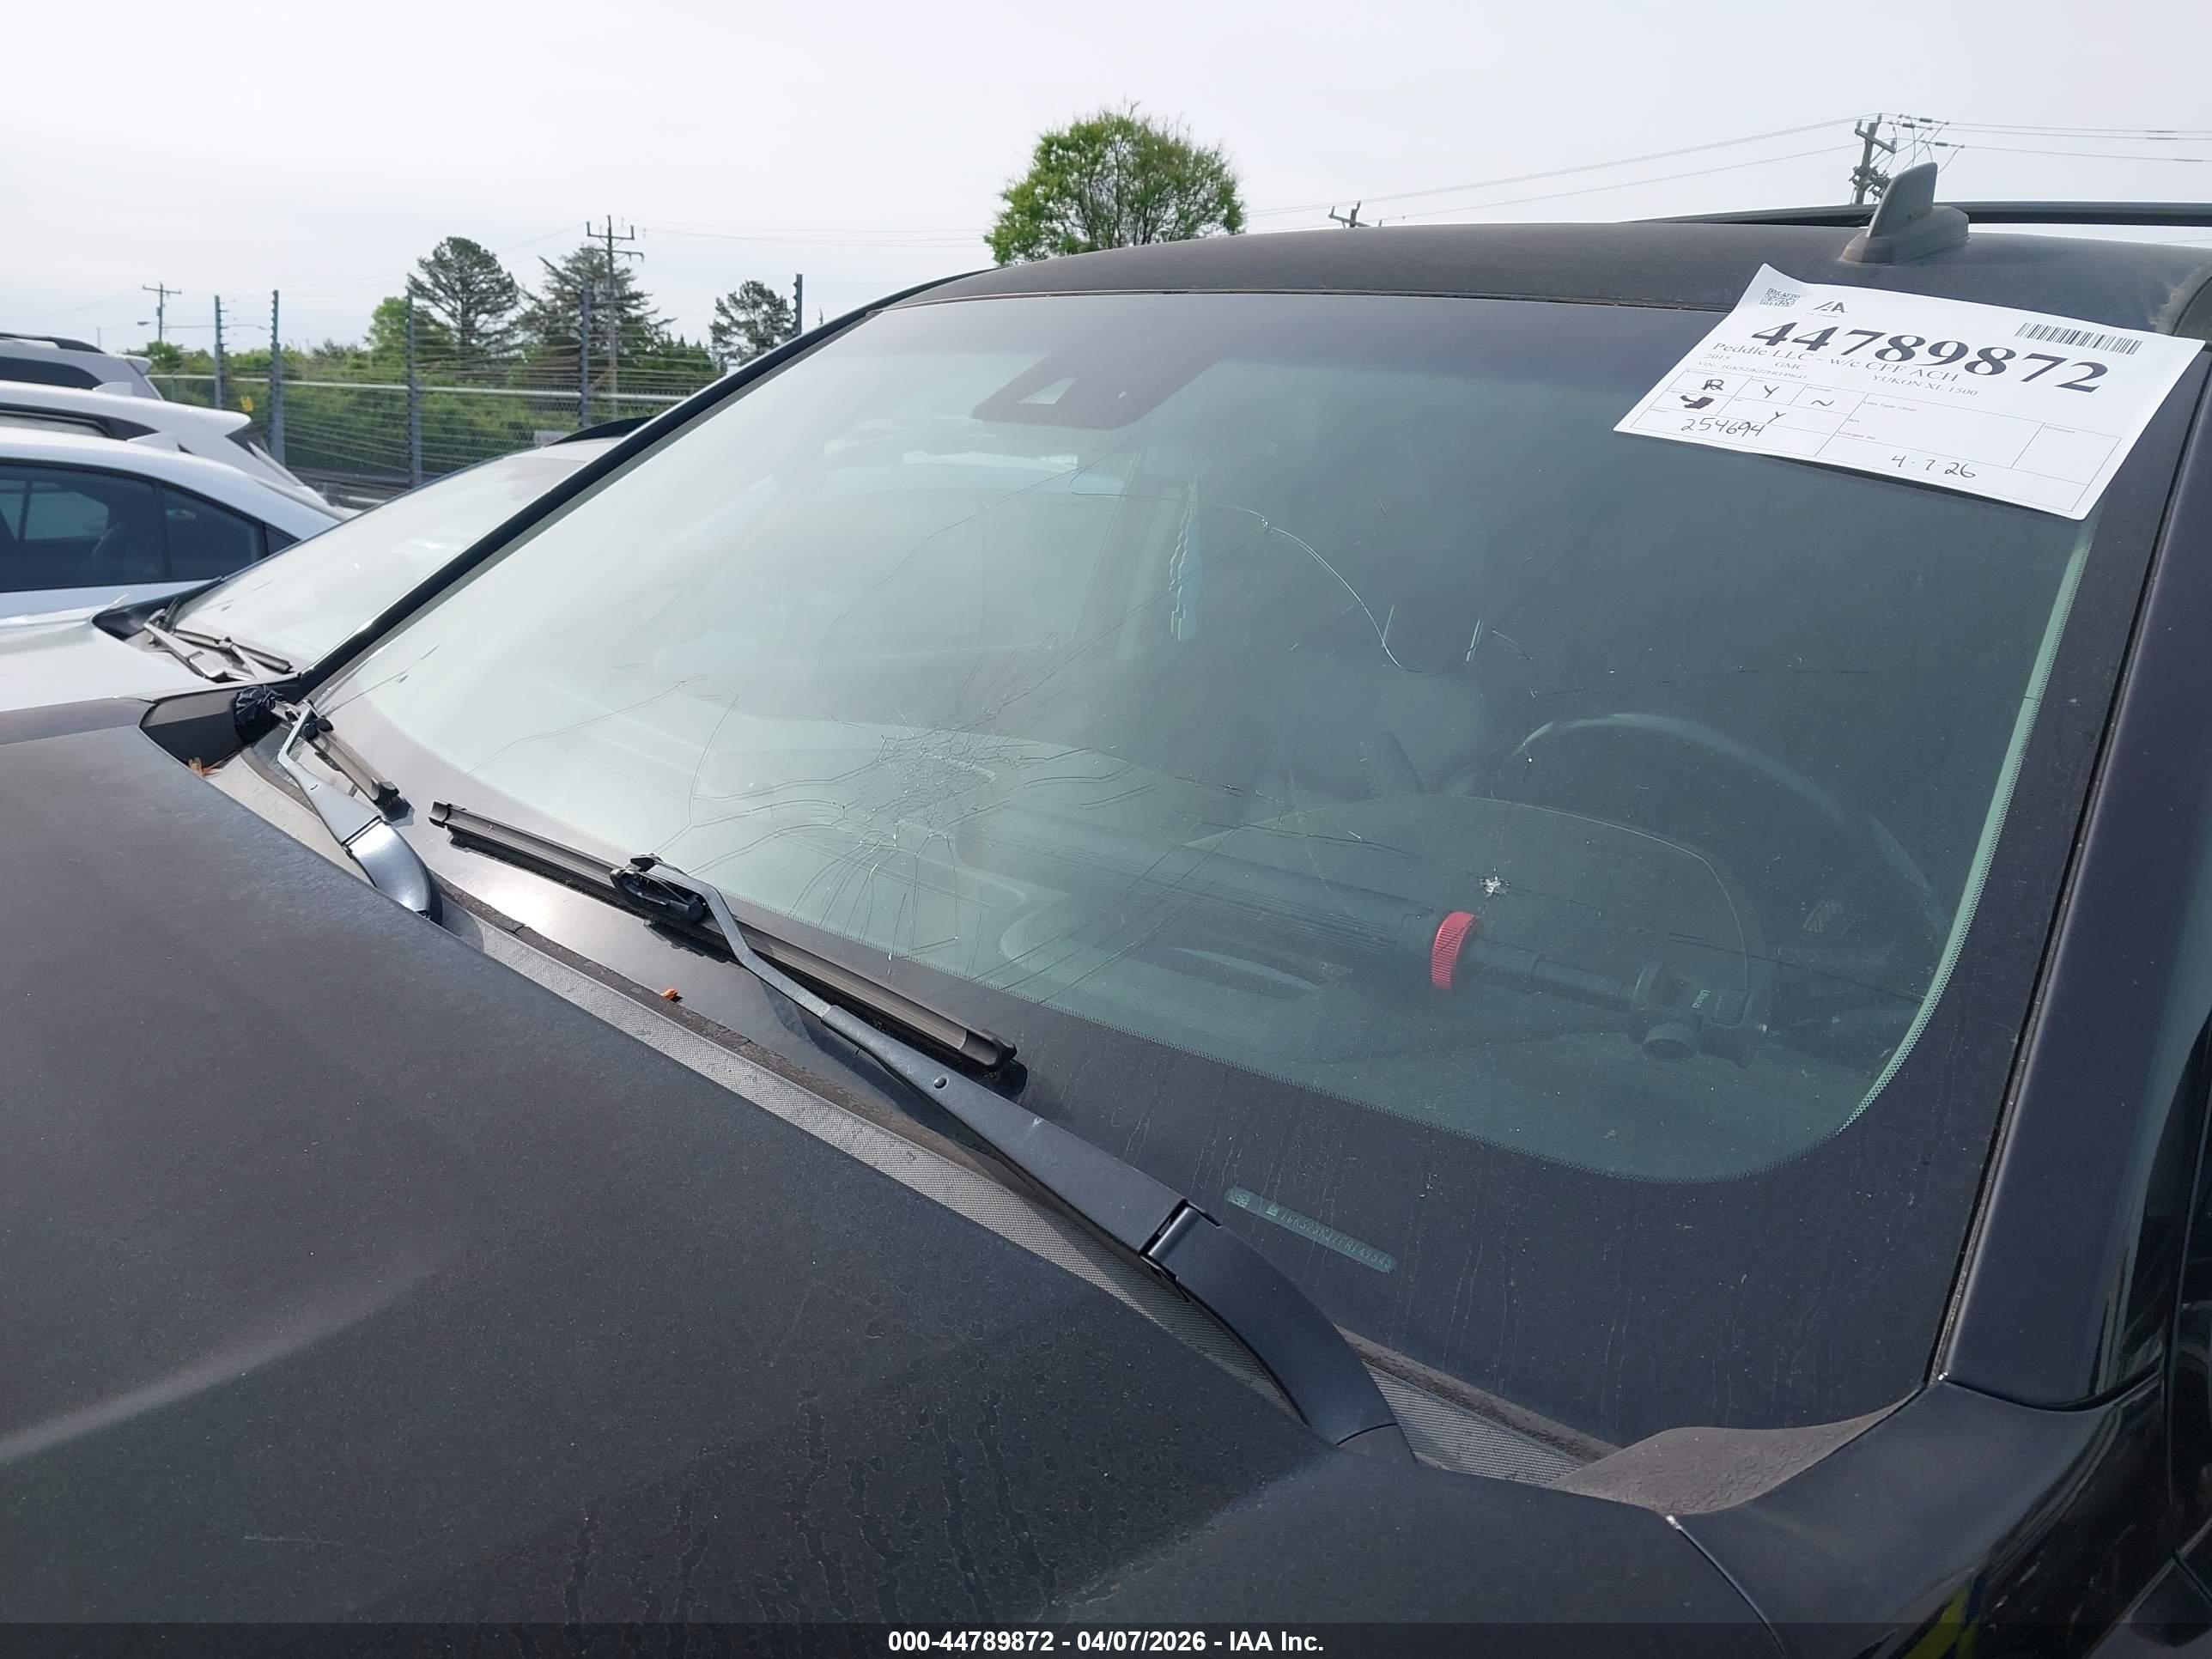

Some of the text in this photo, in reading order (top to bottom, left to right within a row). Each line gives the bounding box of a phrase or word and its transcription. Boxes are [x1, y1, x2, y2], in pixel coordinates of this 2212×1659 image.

[1712, 343, 1768, 356] Peddle
[1772, 349, 1814, 361] LLC
[1910, 369, 1960, 382] ACH
[1751, 322, 2109, 392] 44789872
[1774, 362, 1807, 370] GMC
[1872, 374, 1978, 396] YUKON XL 1500
[1680, 418, 1766, 436] 254694
